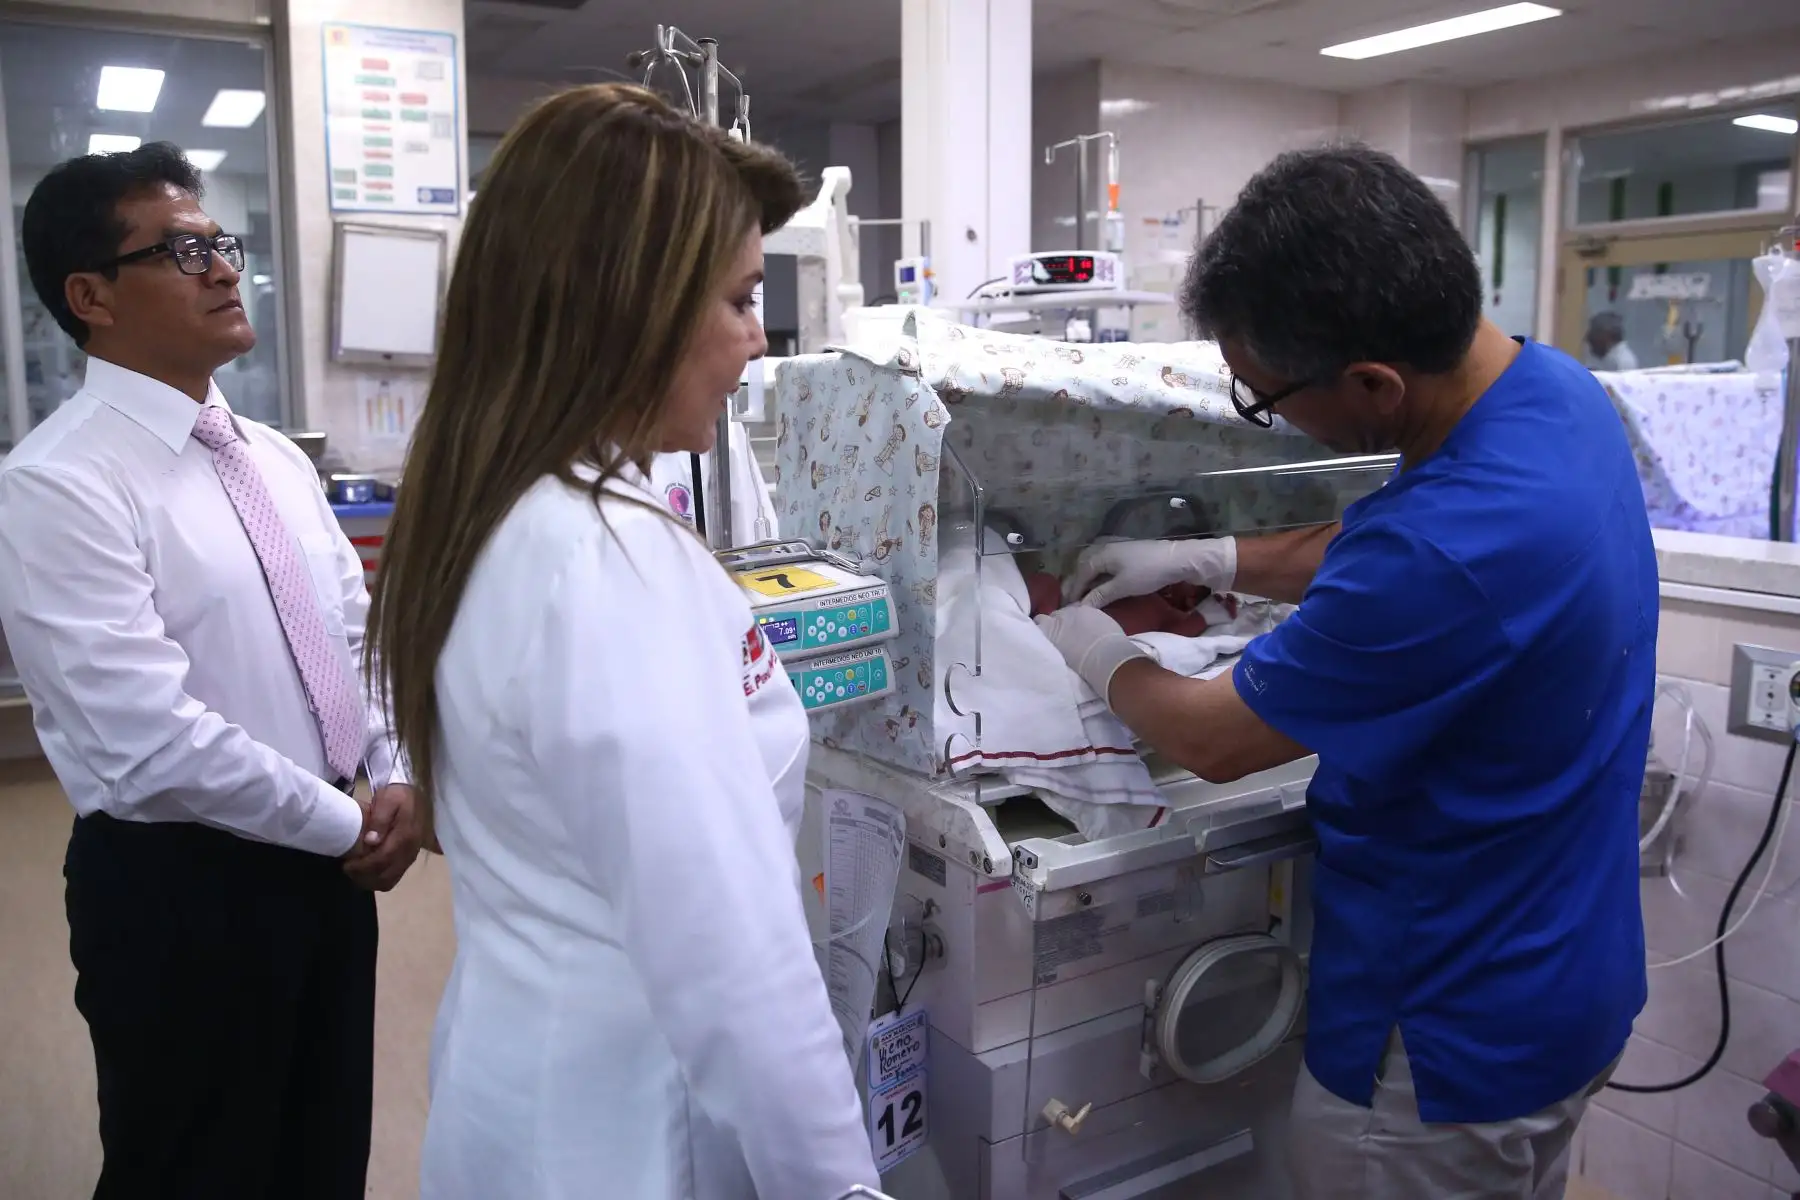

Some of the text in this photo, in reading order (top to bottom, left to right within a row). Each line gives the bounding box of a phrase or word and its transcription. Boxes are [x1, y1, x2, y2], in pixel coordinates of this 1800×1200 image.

[755, 574, 795, 589] 7
[820, 594, 857, 607] INTERMEDIOS
[858, 592, 870, 600] NEO
[812, 655, 851, 668] INTERMEDIOS
[852, 651, 863, 659] NEO
[878, 1090, 922, 1147] 12
